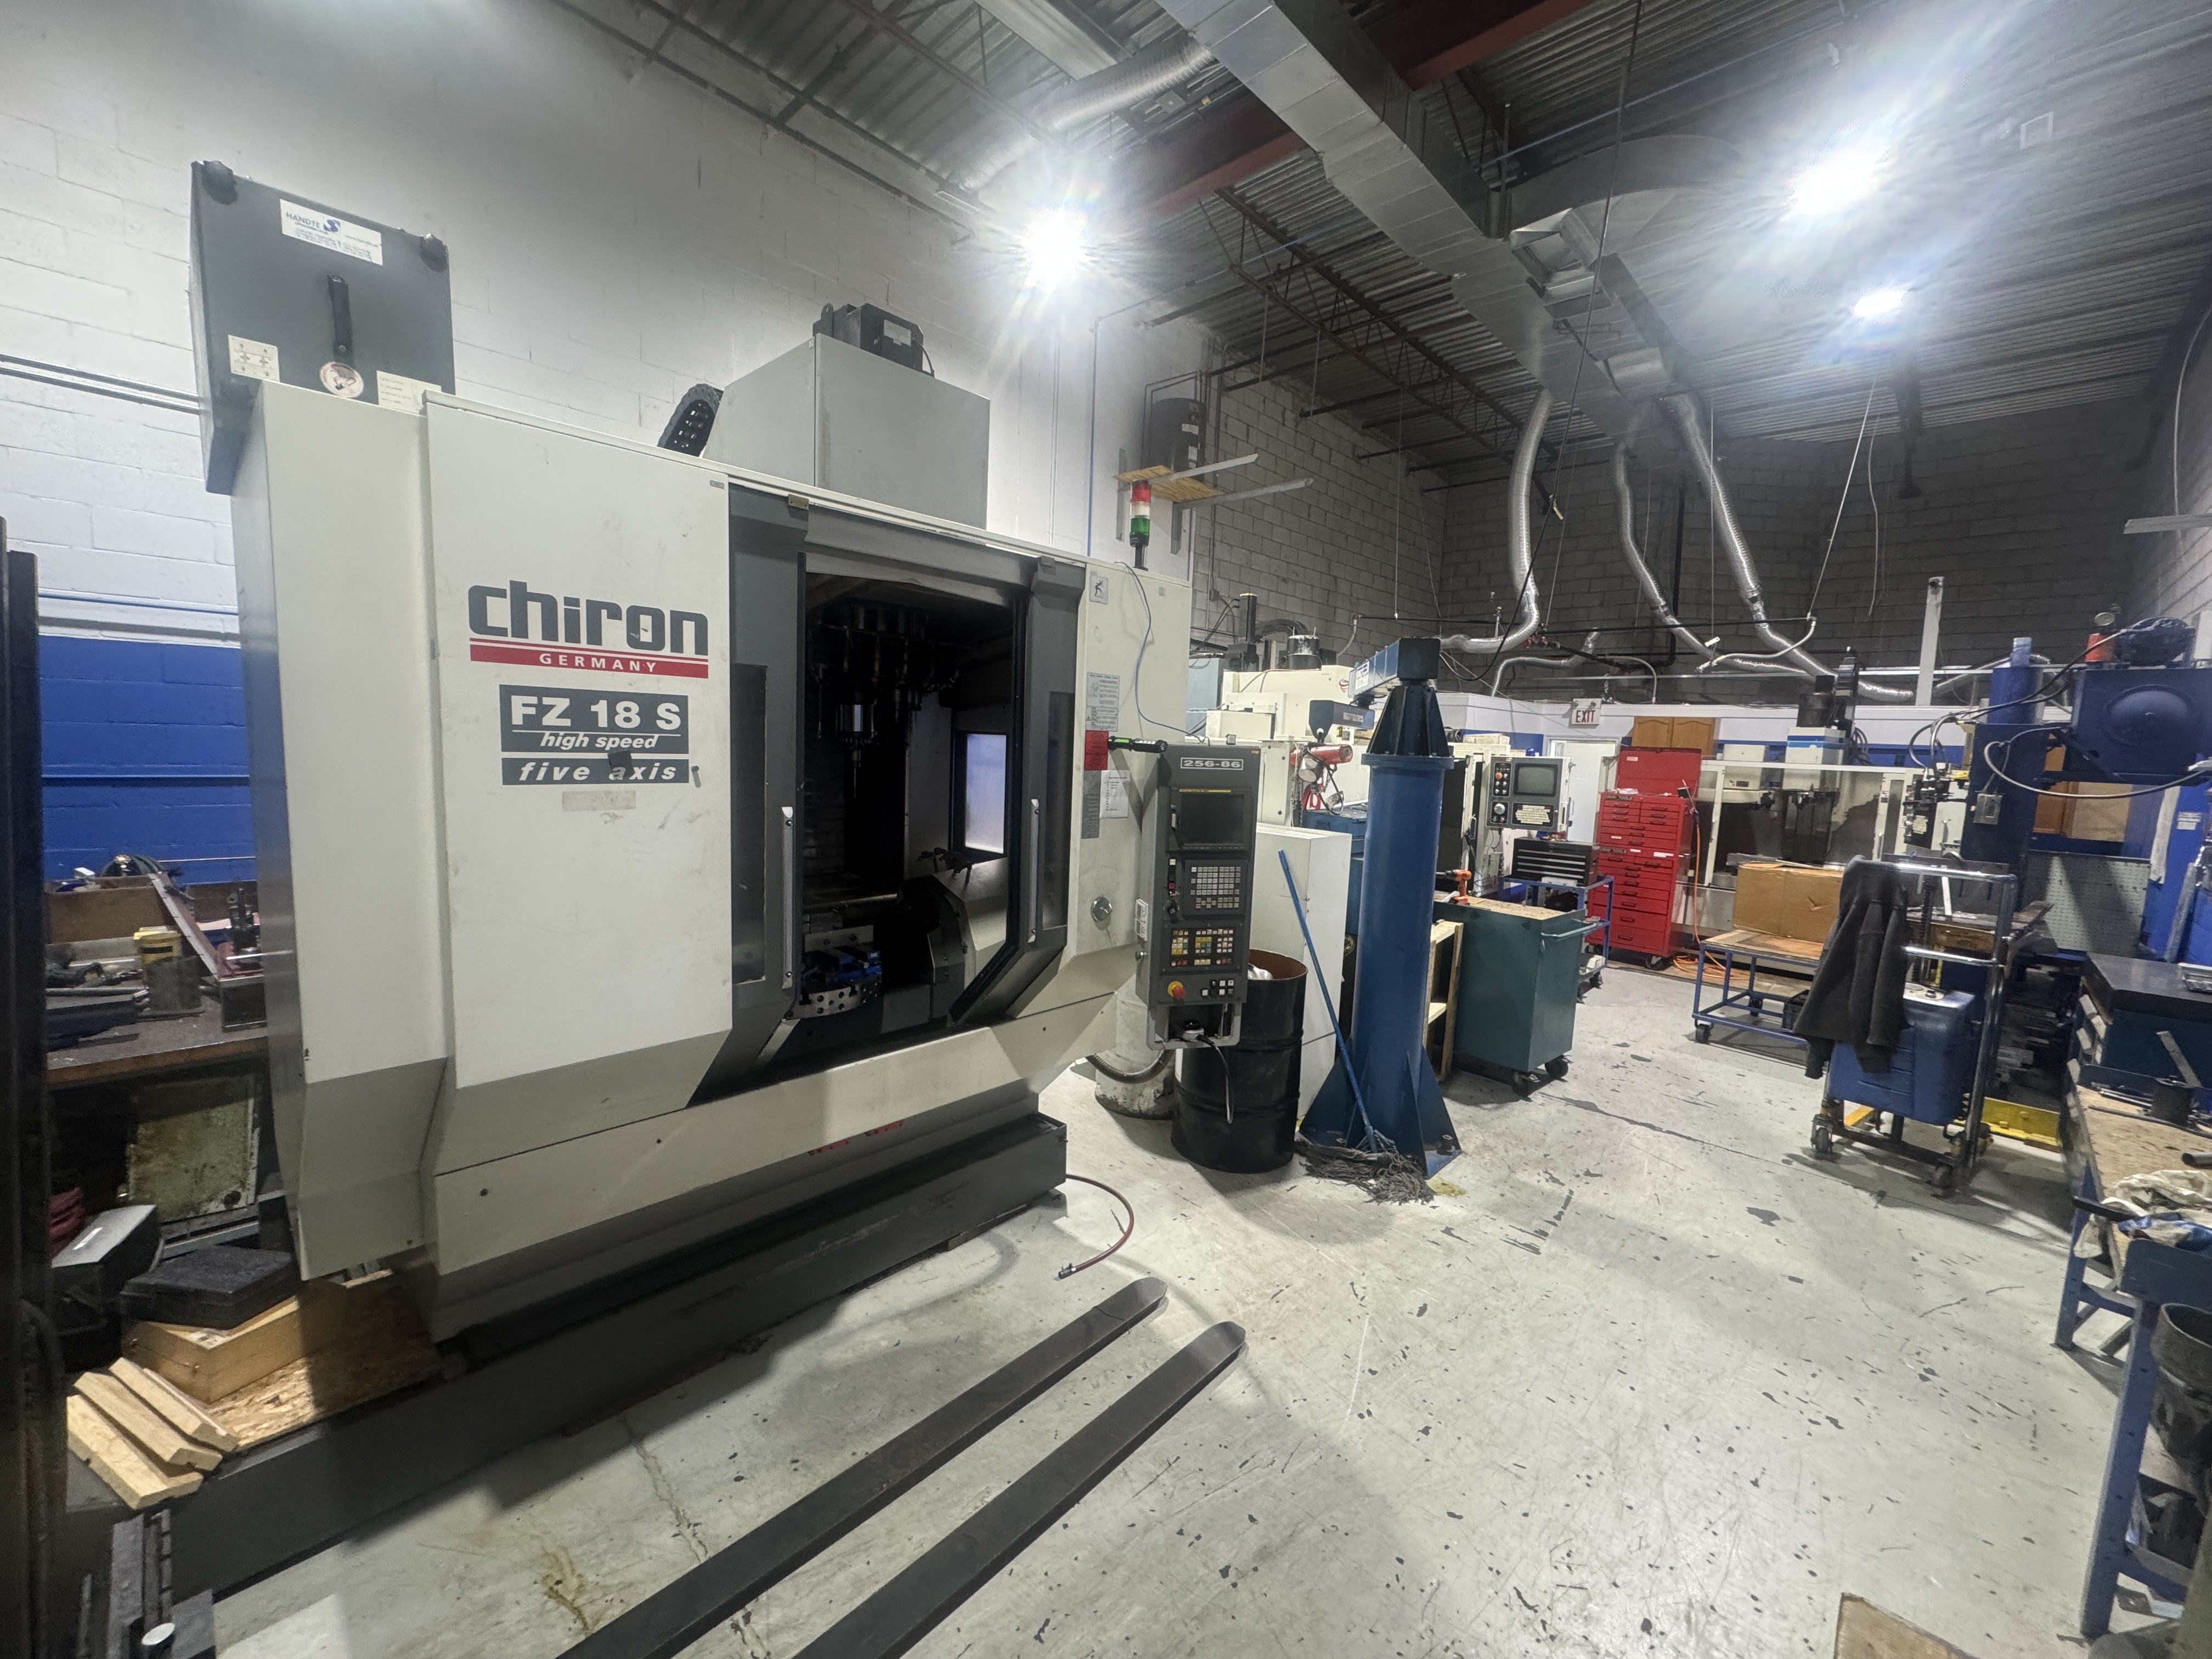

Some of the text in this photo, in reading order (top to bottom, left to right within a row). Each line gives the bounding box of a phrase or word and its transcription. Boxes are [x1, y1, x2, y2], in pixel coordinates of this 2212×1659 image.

[286, 212, 320, 228] HANDTE
[468, 580, 708, 656] chiron
[539, 653, 657, 673] GERMANY
[511, 695, 681, 730] FZ 18 S
[1576, 710, 1596, 723] EXIT
[540, 732, 657, 751] high speed
[519, 762, 676, 781] five axis
[1183, 760, 1241, 768] 256-86
